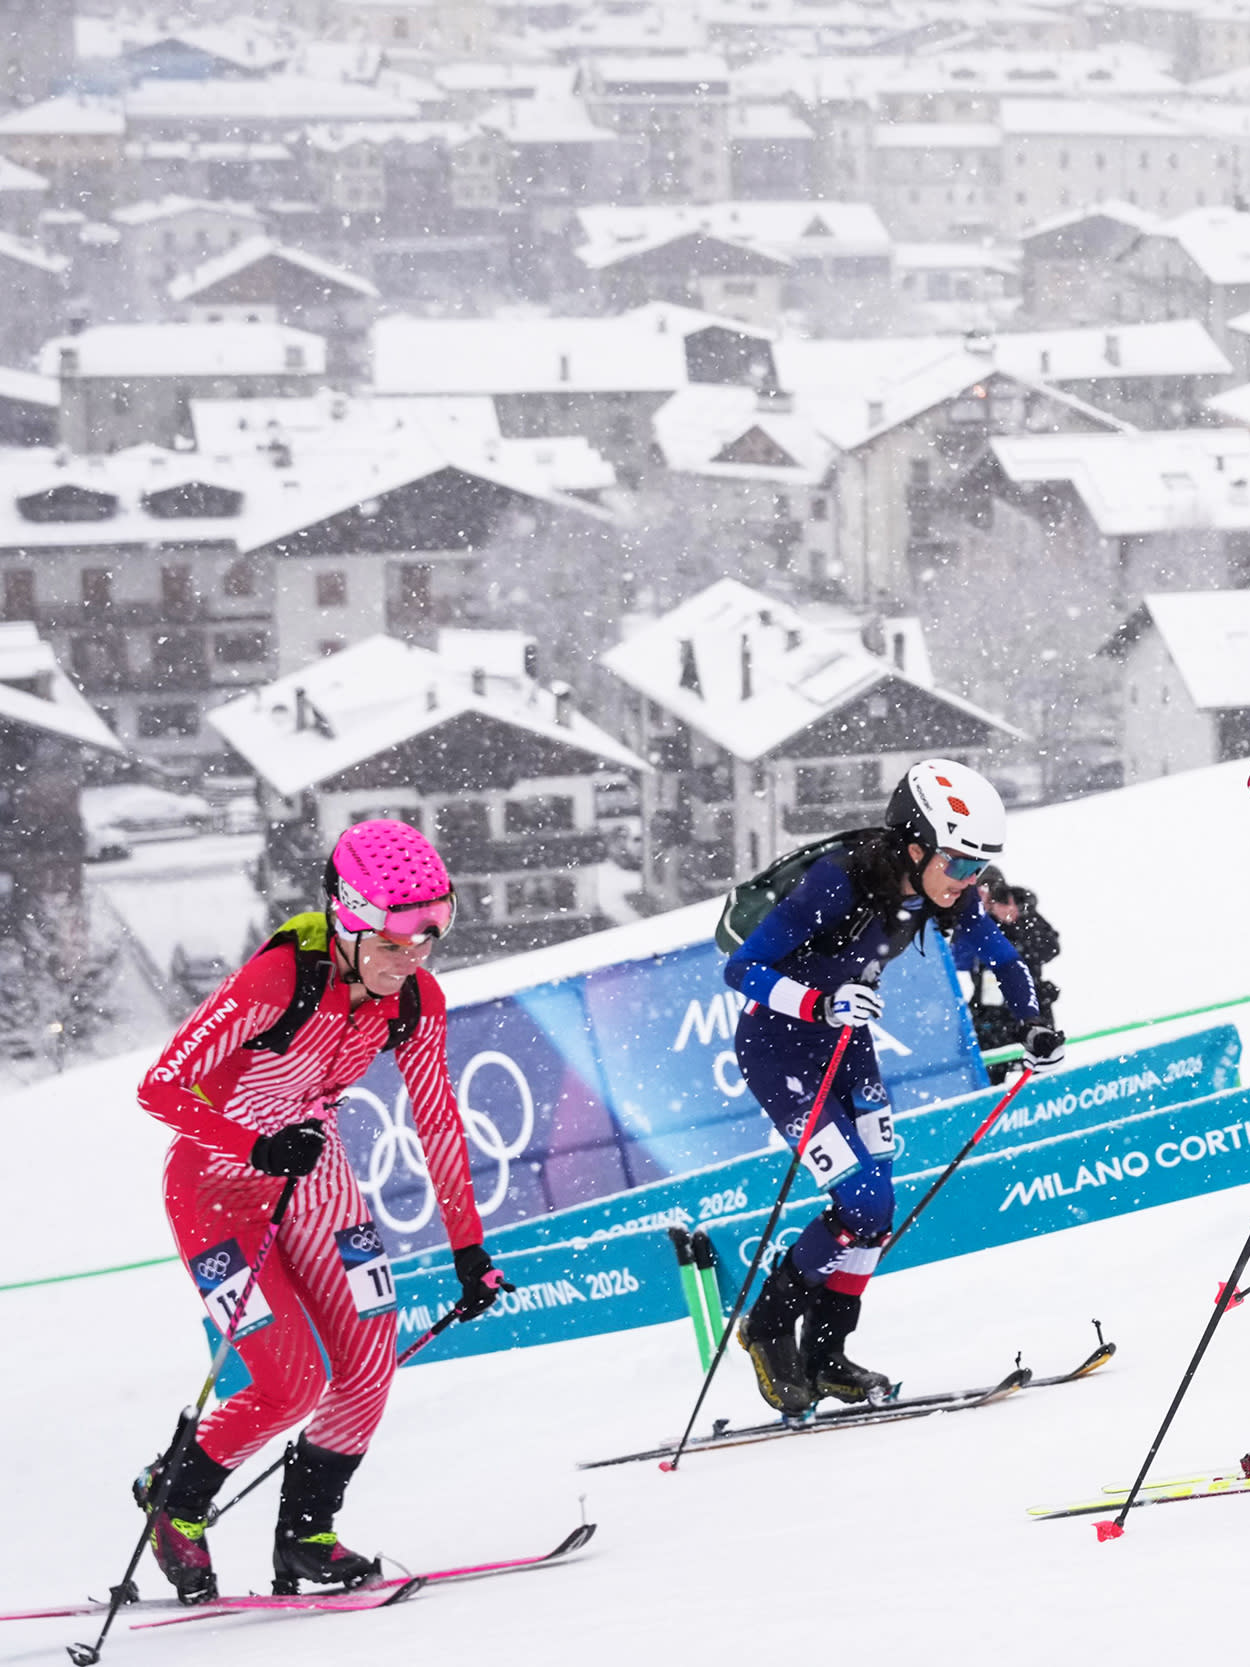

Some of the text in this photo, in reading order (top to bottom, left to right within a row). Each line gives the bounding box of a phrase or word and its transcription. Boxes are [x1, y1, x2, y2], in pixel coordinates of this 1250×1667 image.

[167, 998, 239, 1076] MARTINI
[989, 1093, 1078, 1137] MILANO
[1078, 1070, 1167, 1109] CORTINA
[1163, 1054, 1204, 1083] 2026
[878, 1116, 893, 1143] 5
[809, 1145, 833, 1173] 5
[1000, 1150, 1149, 1211] MILANO
[699, 1186, 748, 1220] 2026
[368, 1265, 392, 1297] 11
[486, 1281, 587, 1318] CORTINA
[586, 1267, 639, 1300] 2026
